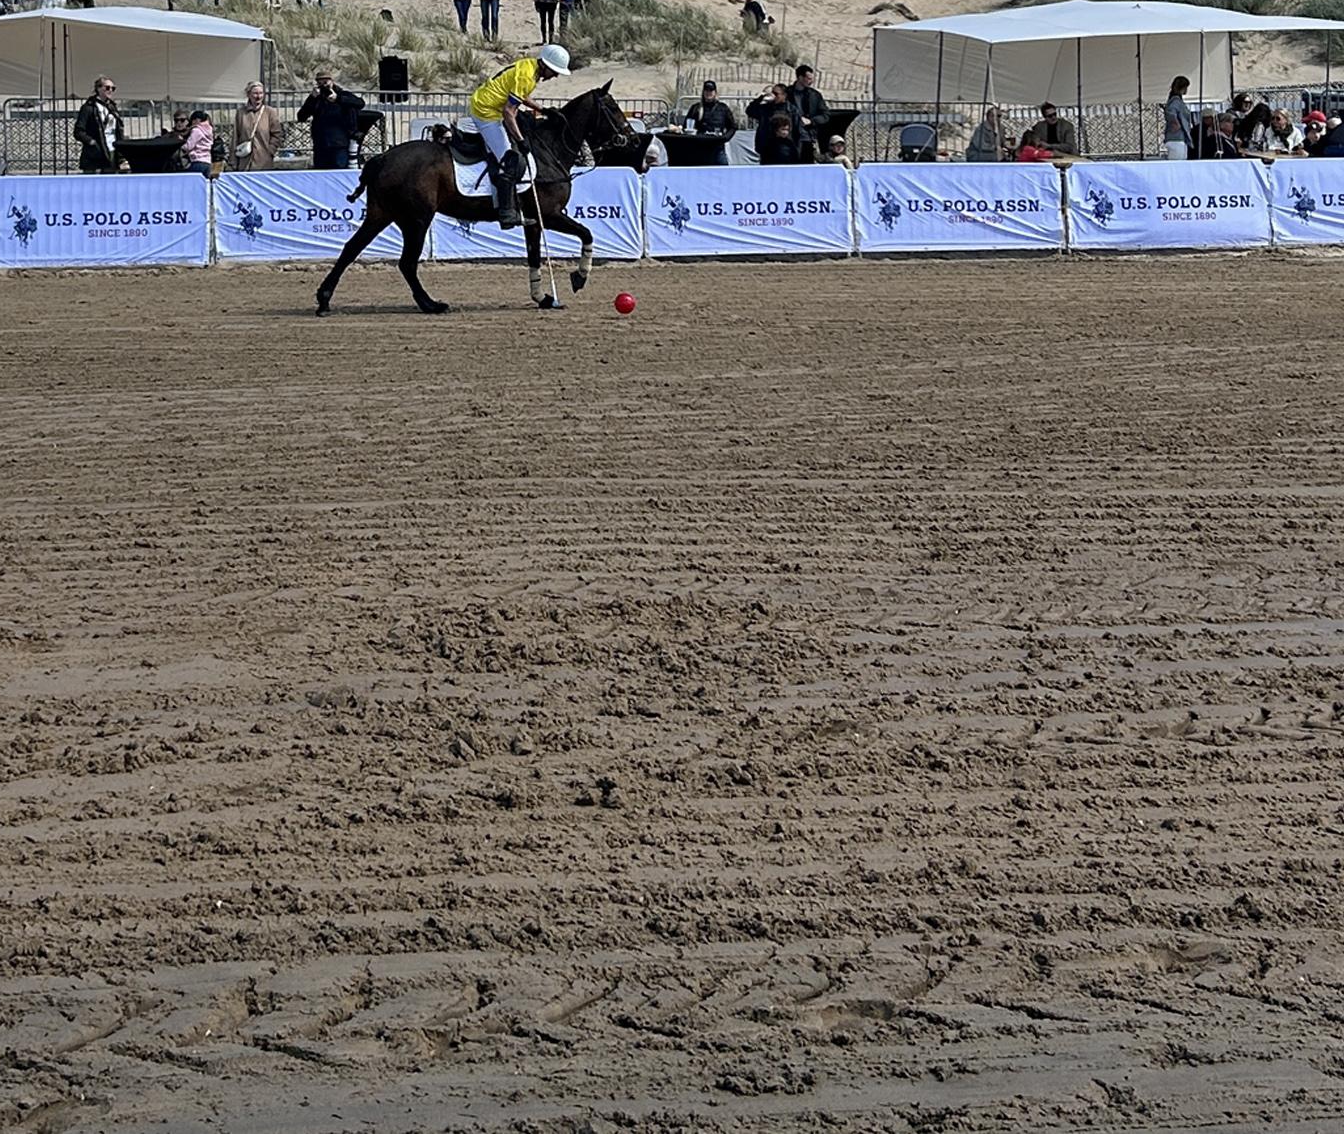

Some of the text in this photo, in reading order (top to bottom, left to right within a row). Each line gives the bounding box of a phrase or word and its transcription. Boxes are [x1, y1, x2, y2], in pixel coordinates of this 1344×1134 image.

[907, 200, 1044, 212] U.S. POLO ASSN.
[1120, 196, 1255, 210] U.S. POLO ASSN.
[1322, 194, 1344, 206] U.S
[573, 206, 625, 218] ASSN.
[697, 201, 835, 215] U.S. POLO ASSN.
[45, 211, 192, 226] U.S. POLO ASSN.
[270, 209, 301, 222] U.S.
[306, 208, 353, 221] POLO
[948, 216, 977, 224] SINCE
[1162, 212, 1216, 221] SINCE 1890
[738, 218, 794, 226] SINCE 1890
[88, 228, 148, 238] SINCE 1890
[313, 224, 343, 233] SINCE
